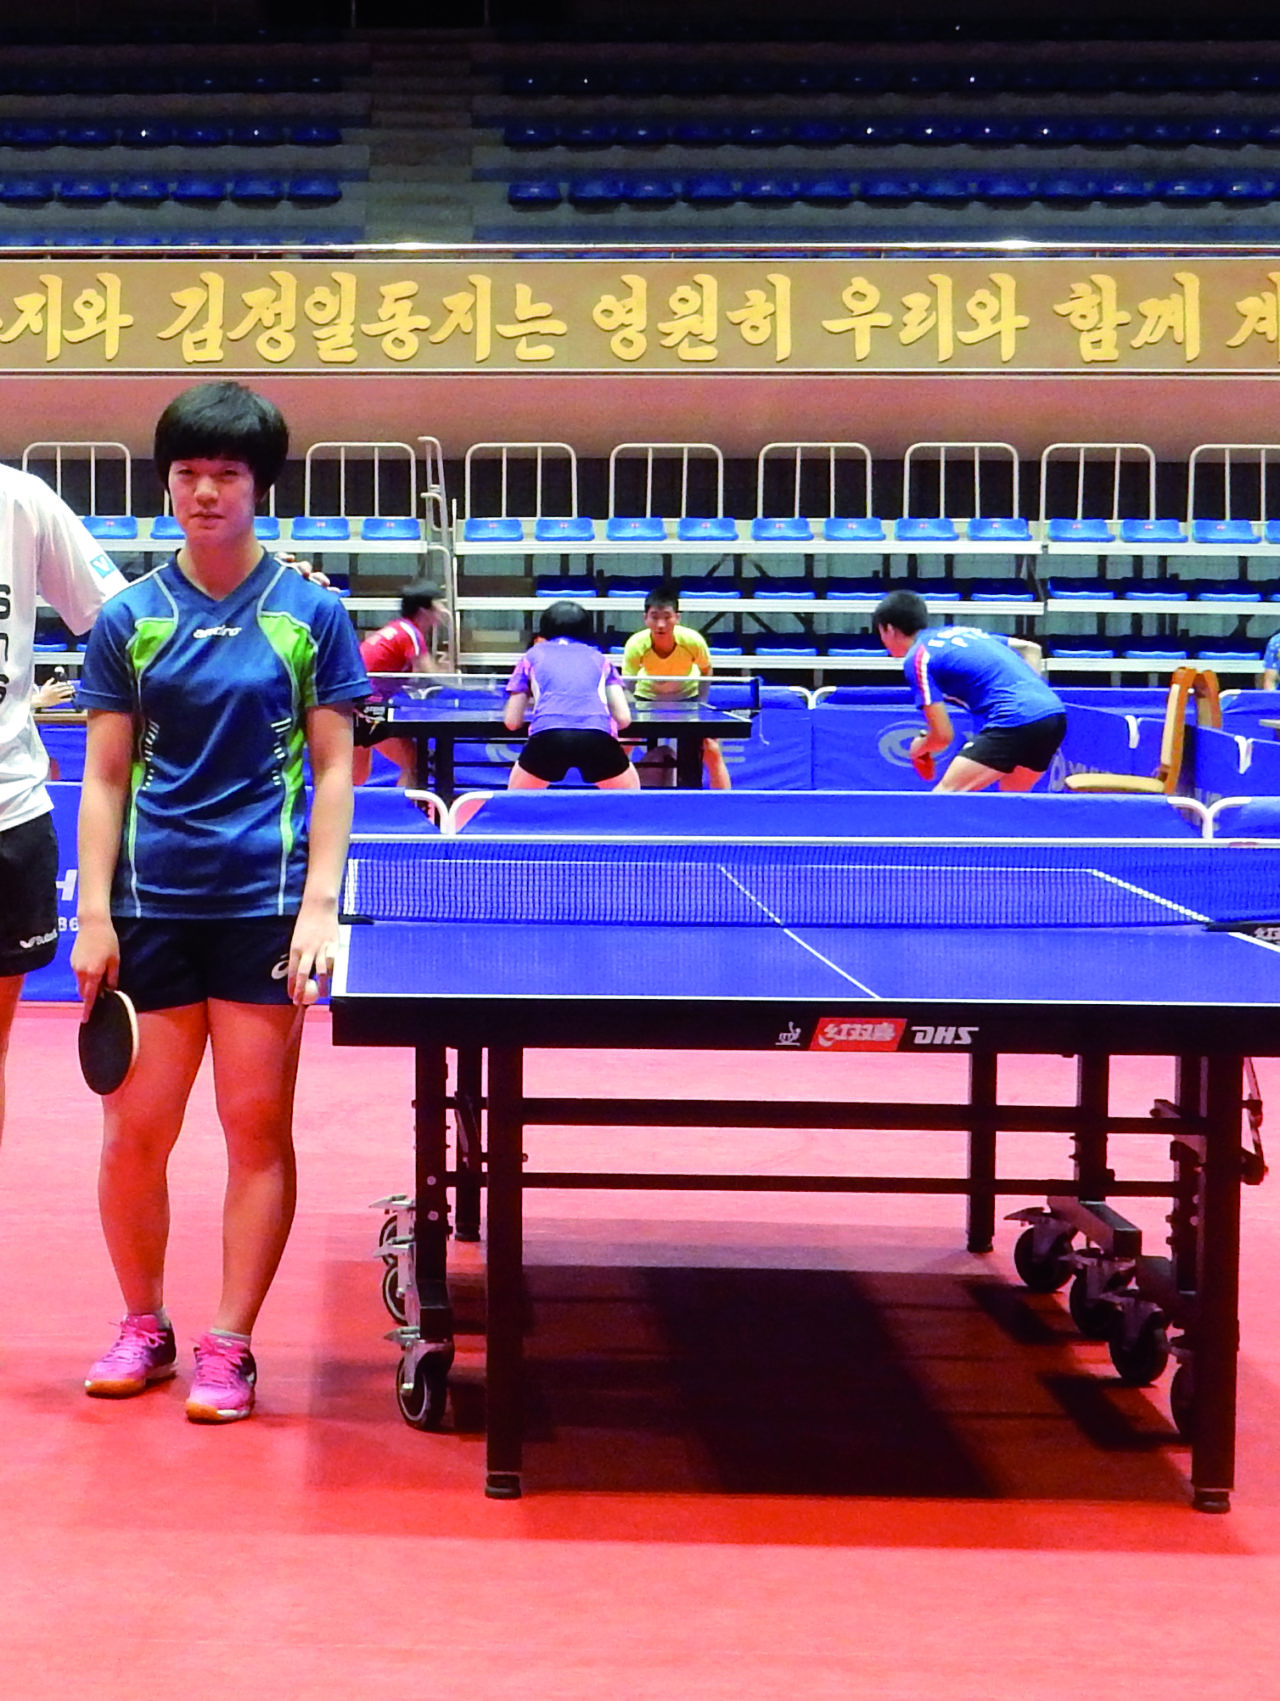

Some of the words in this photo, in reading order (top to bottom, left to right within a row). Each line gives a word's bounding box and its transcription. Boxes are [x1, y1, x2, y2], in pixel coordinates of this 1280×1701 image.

[157, 270, 567, 363] 김정일동지는
[592, 272, 791, 362] 영원히
[822, 272, 1030, 362] 우리와
[1053, 271, 1201, 362] 함께
[911, 1026, 980, 1045] DHS
